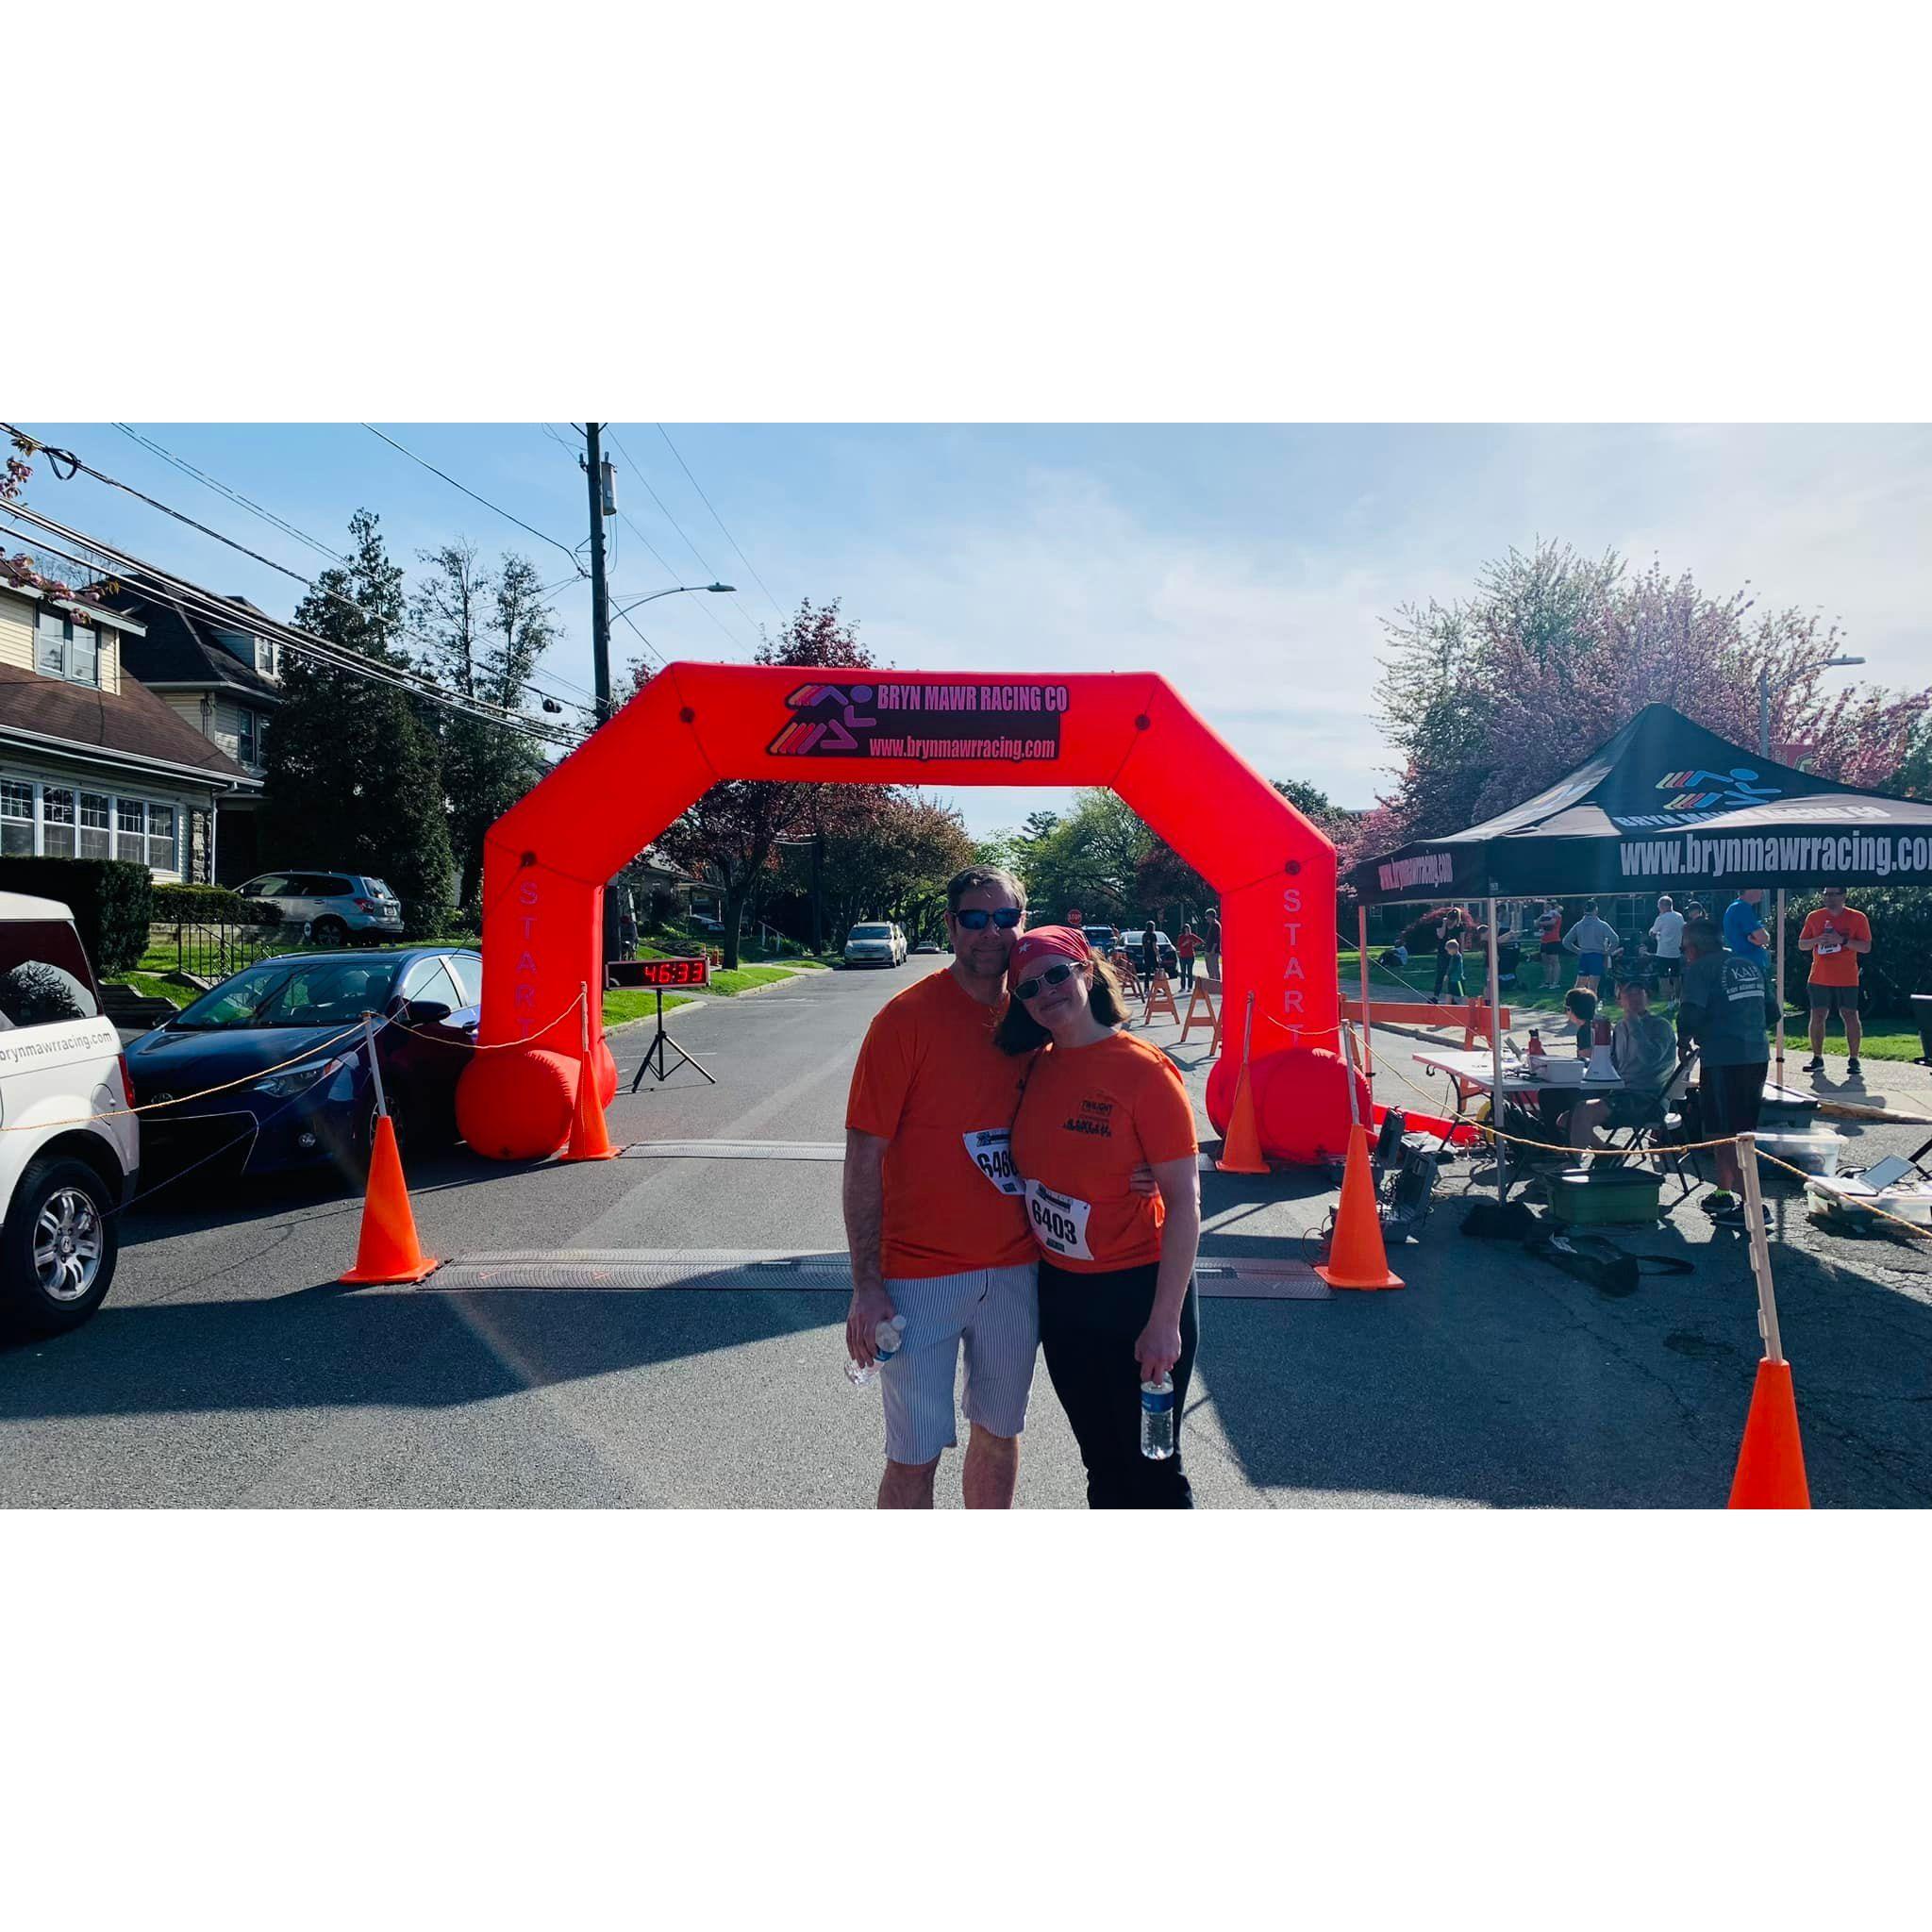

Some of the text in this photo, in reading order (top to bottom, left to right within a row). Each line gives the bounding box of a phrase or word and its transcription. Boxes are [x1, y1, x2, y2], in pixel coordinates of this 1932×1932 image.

[877, 685, 1068, 711] BRYN MAWR RACING CO
[869, 735, 1056, 760] www.brynmawrracing.com
[1611, 814, 1684, 826] BRYN
[1620, 830, 1932, 876] www.brynmawrracing.co
[516, 881, 539, 1039] START
[644, 962, 704, 984] 46:33
[1283, 889, 1306, 1047] START
[1031, 1199, 1077, 1245] 6403
